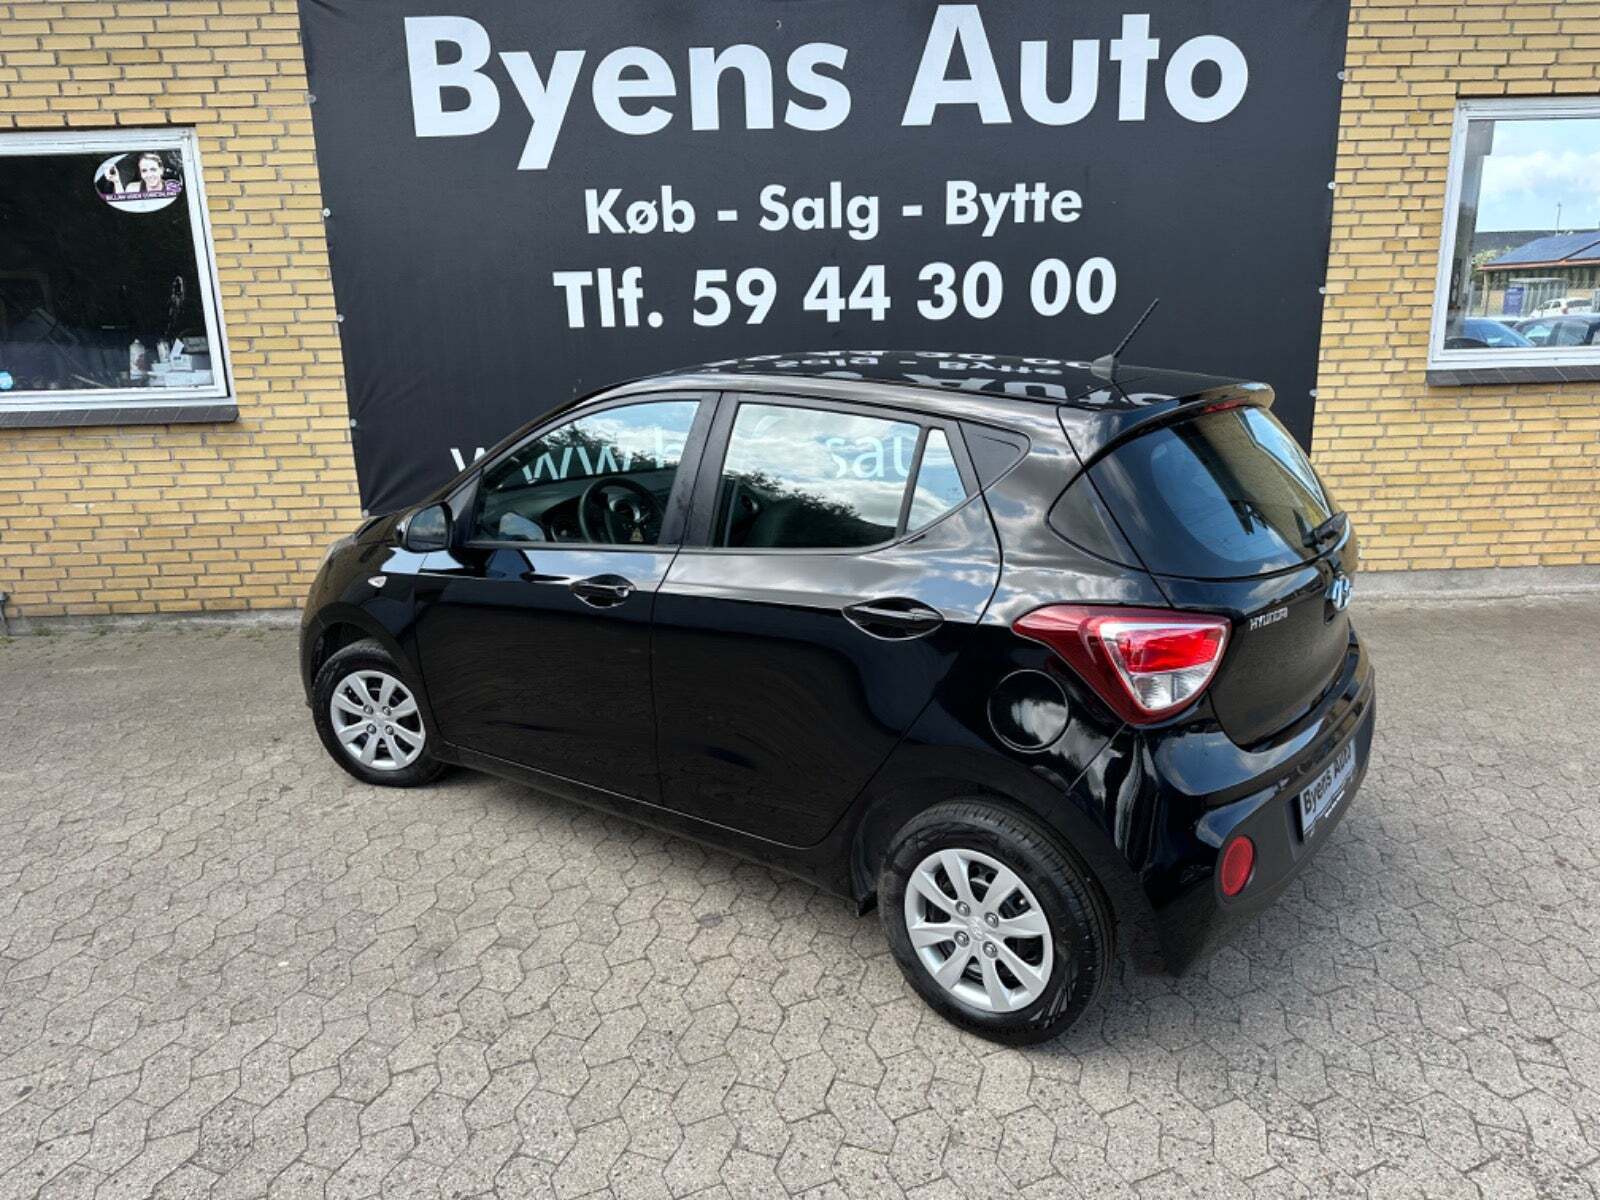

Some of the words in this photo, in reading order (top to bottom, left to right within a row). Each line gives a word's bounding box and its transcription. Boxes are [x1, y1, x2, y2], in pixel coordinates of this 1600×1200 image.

[403, 16, 852, 171] Byens
[901, 5, 1249, 127] Auto
[584, 184, 696, 234] Køb
[759, 180, 879, 241] Salg
[945, 180, 1083, 238] Bytte
[552, 266, 664, 329] Tlf.
[693, 267, 777, 327] 59
[803, 264, 891, 323] 44
[916, 260, 1003, 321] 30
[1030, 256, 1117, 317] 00
[1302, 768, 1333, 815] Byens
